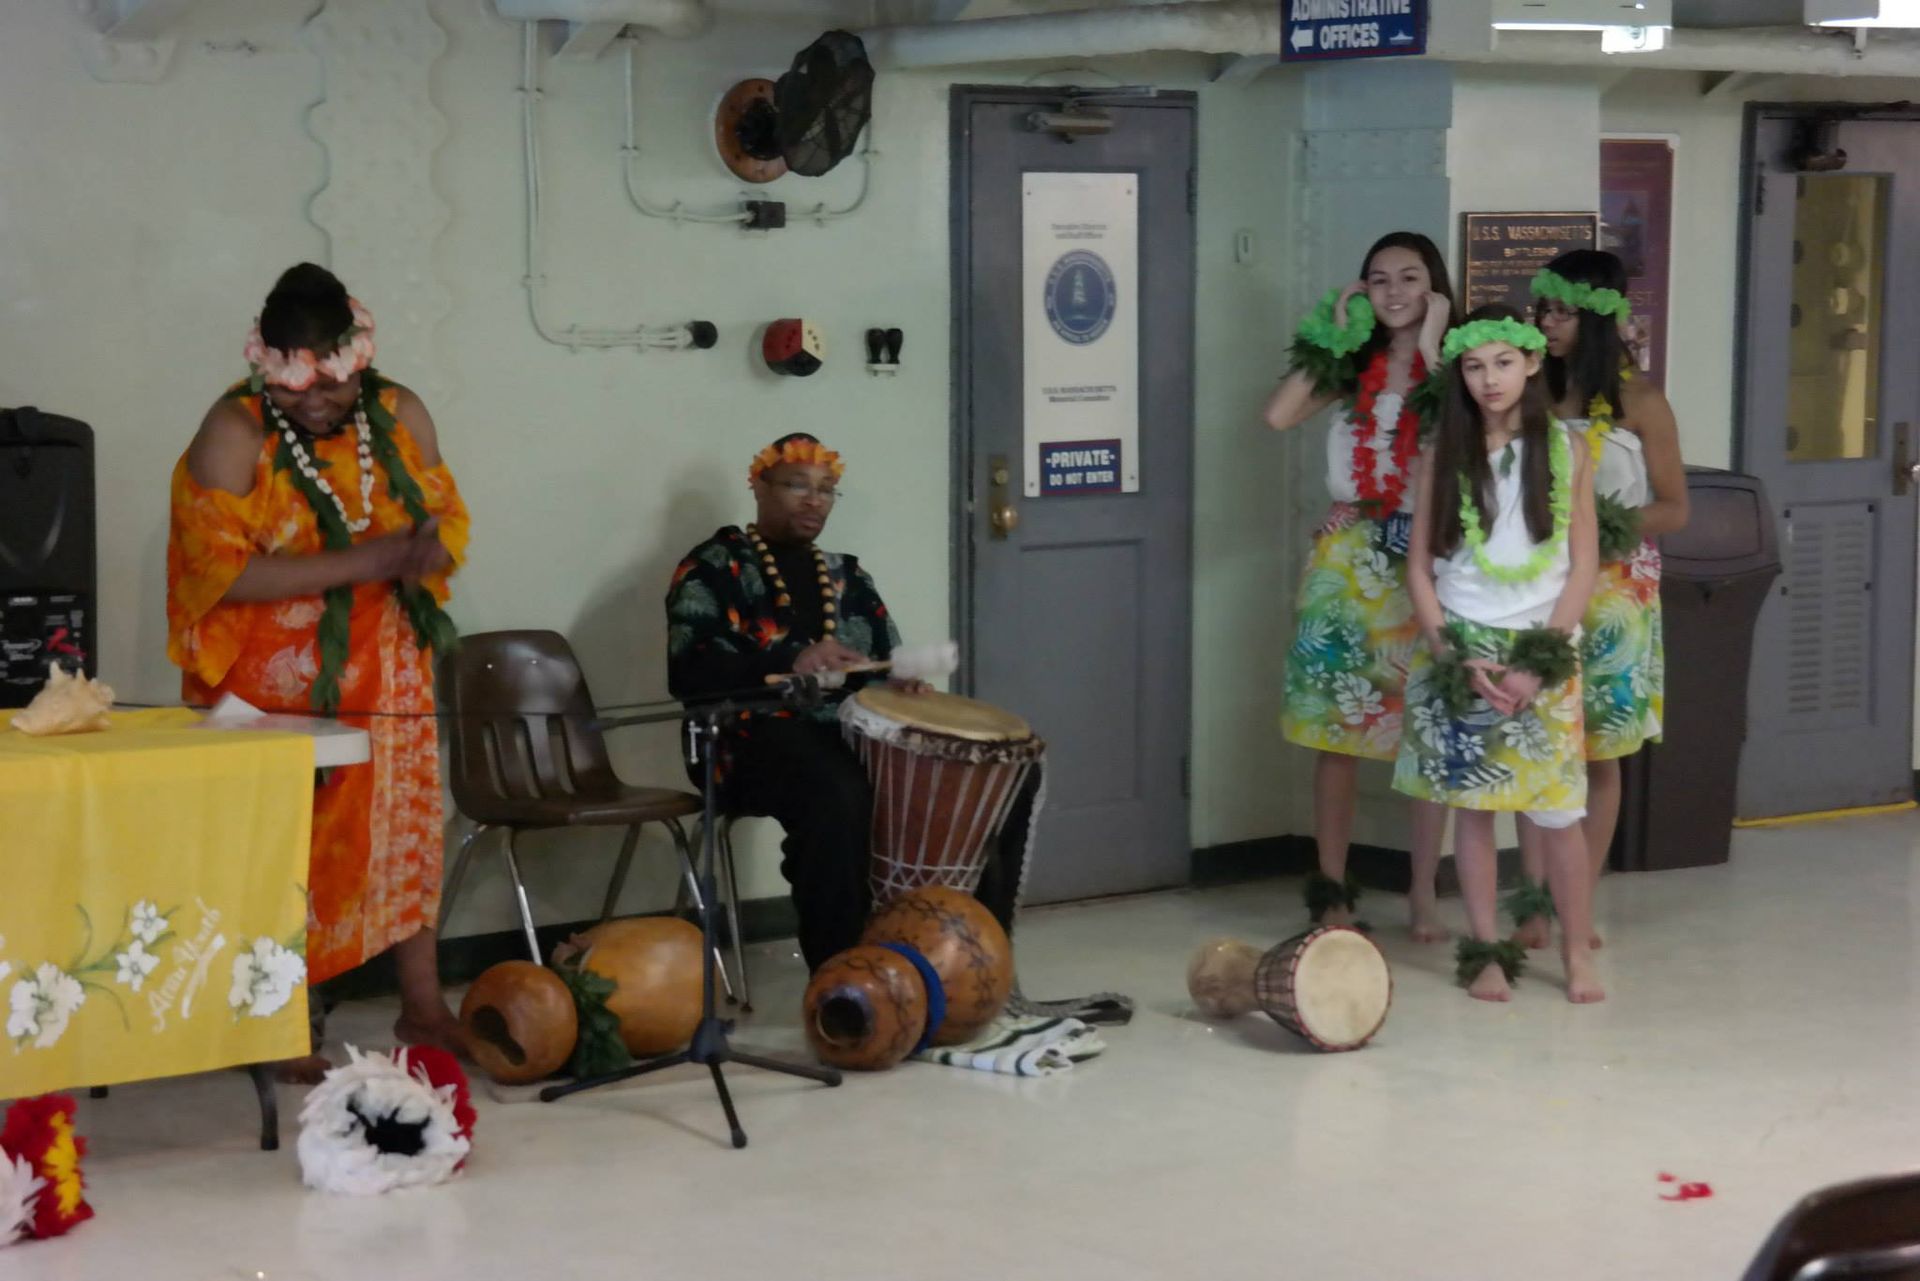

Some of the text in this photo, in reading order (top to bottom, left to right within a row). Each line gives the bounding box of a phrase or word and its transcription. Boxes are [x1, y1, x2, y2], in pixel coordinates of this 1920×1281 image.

[1291, 0, 1411, 21] ADMINISTRATIVE
[1320, 22, 1380, 49] OFFICES
[1049, 470, 1114, 486] DO NOT ENTER
